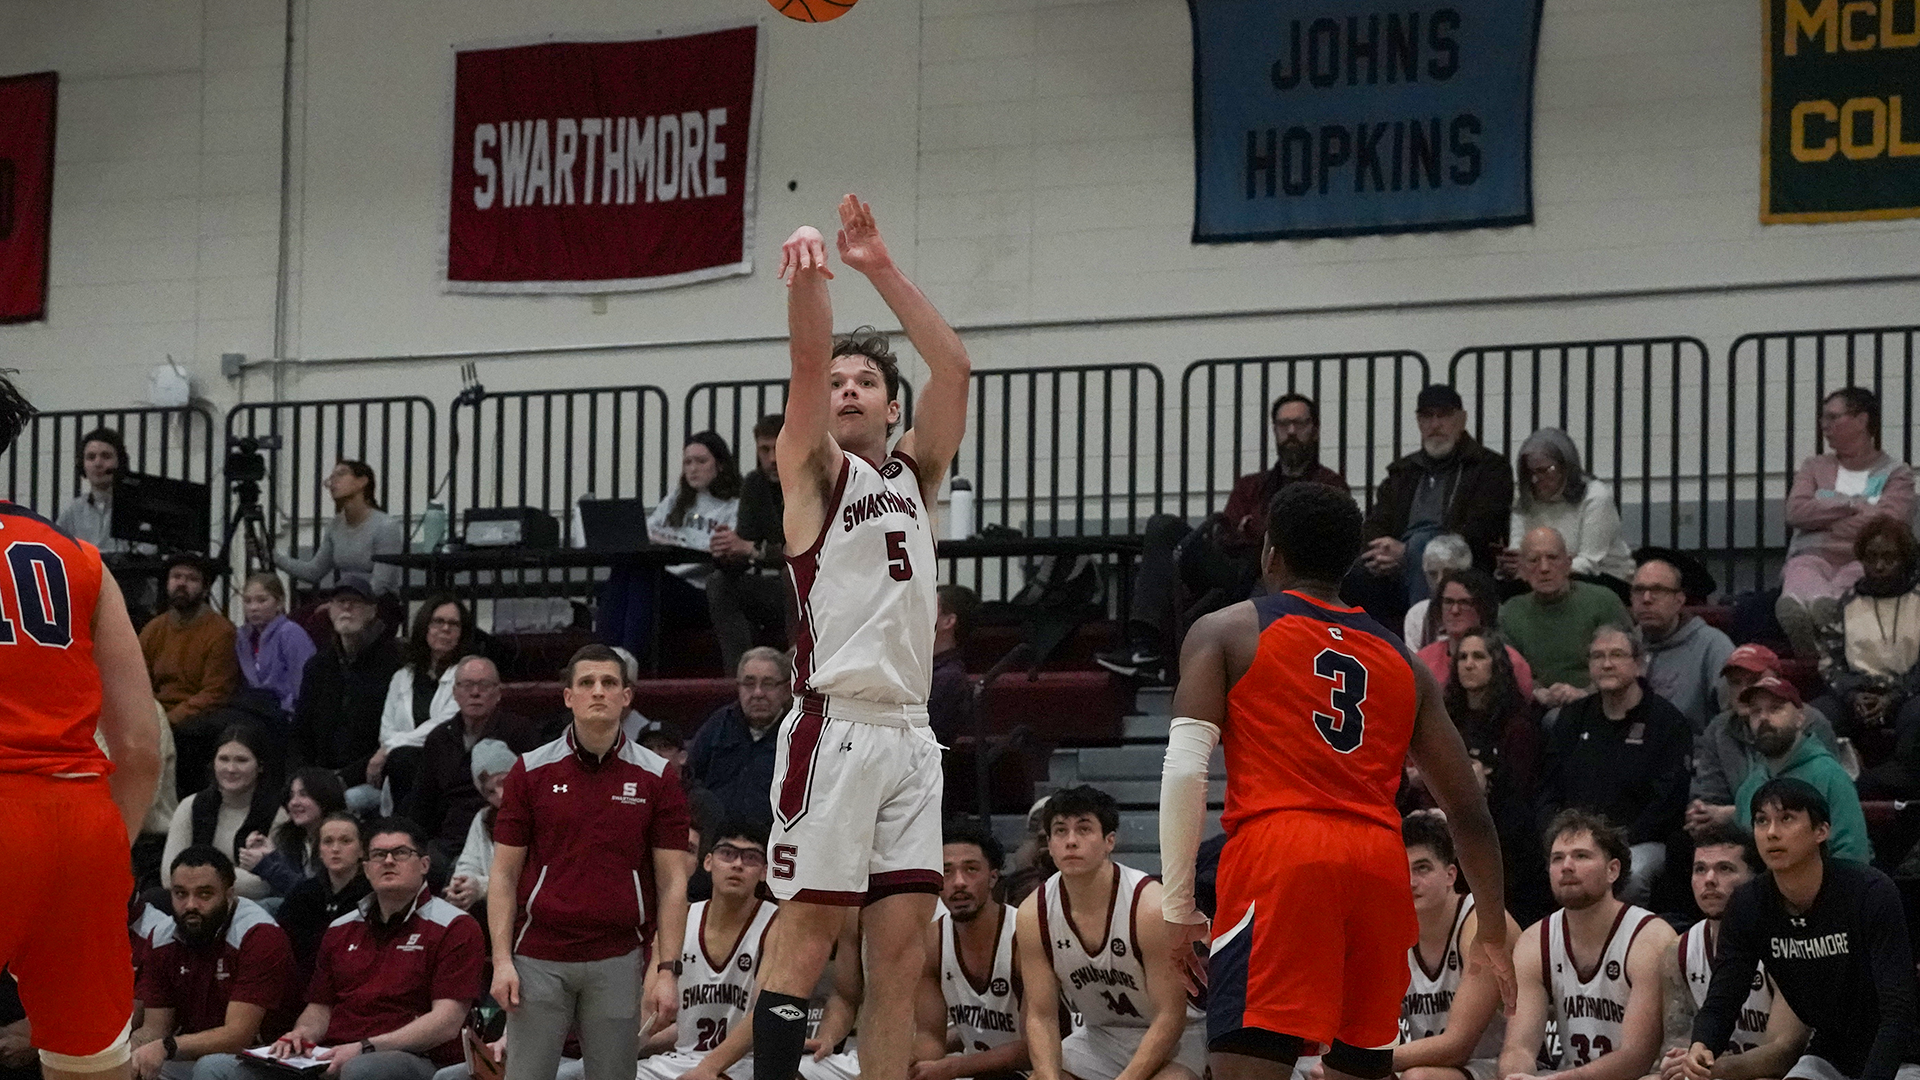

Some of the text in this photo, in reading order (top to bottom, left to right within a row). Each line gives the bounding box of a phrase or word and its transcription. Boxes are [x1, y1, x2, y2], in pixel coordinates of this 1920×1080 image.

[1271, 8, 1461, 90] JOHNS
[473, 107, 728, 210] SWARTHMORE
[1246, 113, 1482, 200] HOPKINS
[882, 463, 899, 477] 22
[885, 531, 913, 582] 5
[1327, 627, 1344, 640] C
[1313, 647, 1368, 754] 3
[623, 782, 638, 796] S
[772, 843, 799, 881] S
[1112, 939, 1125, 953] 22
[1771, 932, 1849, 959] SATHMORE
[738, 956, 751, 967] 22
[1607, 964, 1619, 976] 22
[993, 981, 1007, 992] 22
[780, 1008, 800, 1017] PRO
[692, 1017, 728, 1052] 20
